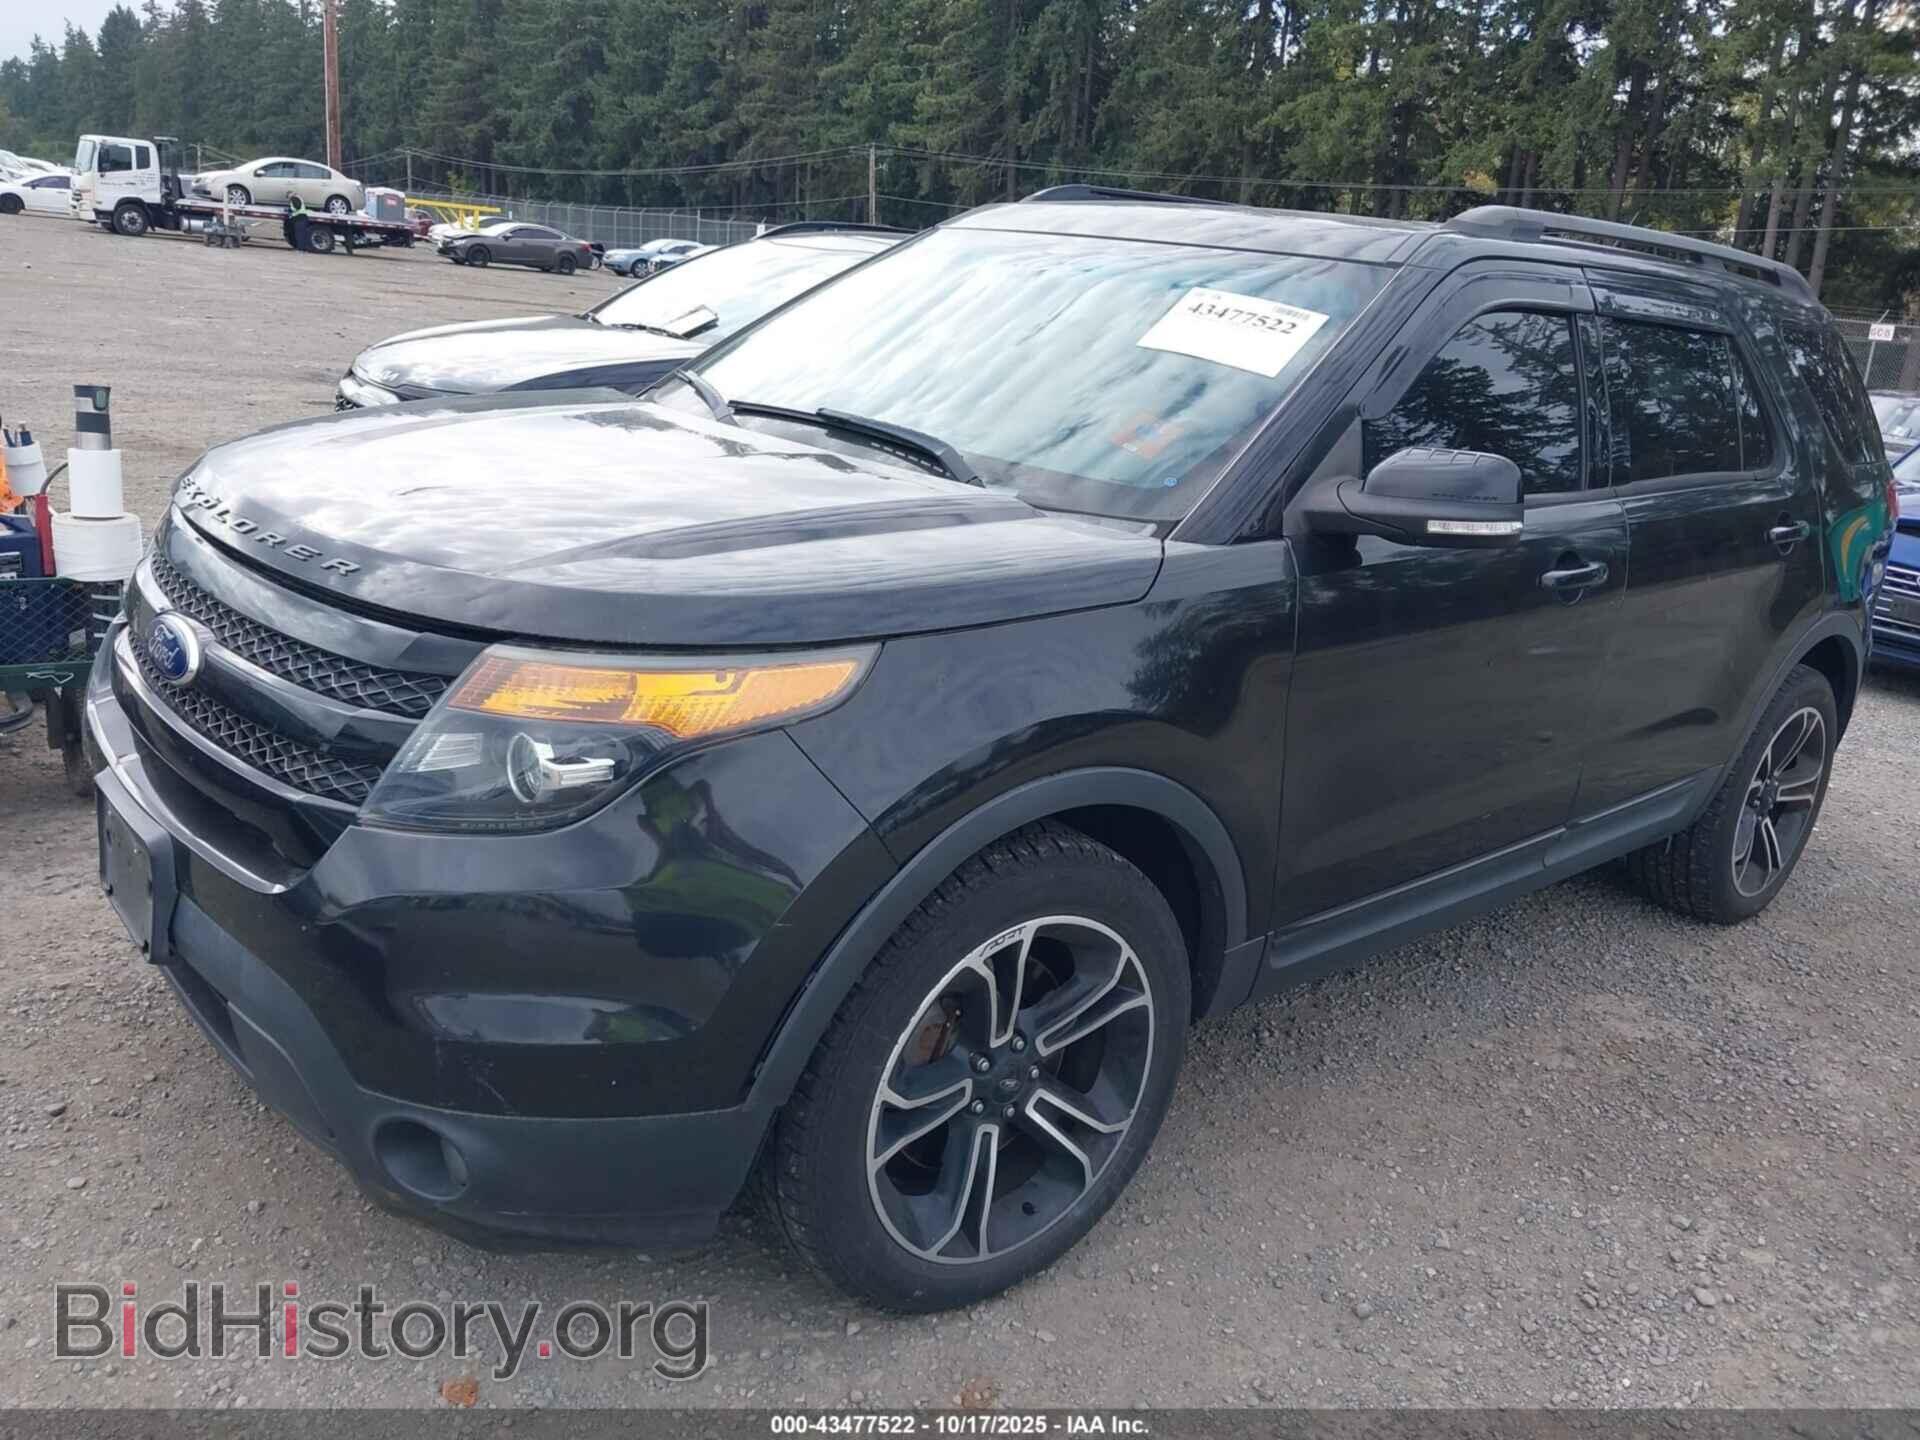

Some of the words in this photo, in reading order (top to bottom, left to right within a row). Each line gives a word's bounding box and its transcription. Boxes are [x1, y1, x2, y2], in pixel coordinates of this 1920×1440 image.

[1187, 302, 1299, 335] 43477522
[181, 476, 362, 577] EXPLORER
[148, 623, 182, 669] Ford
